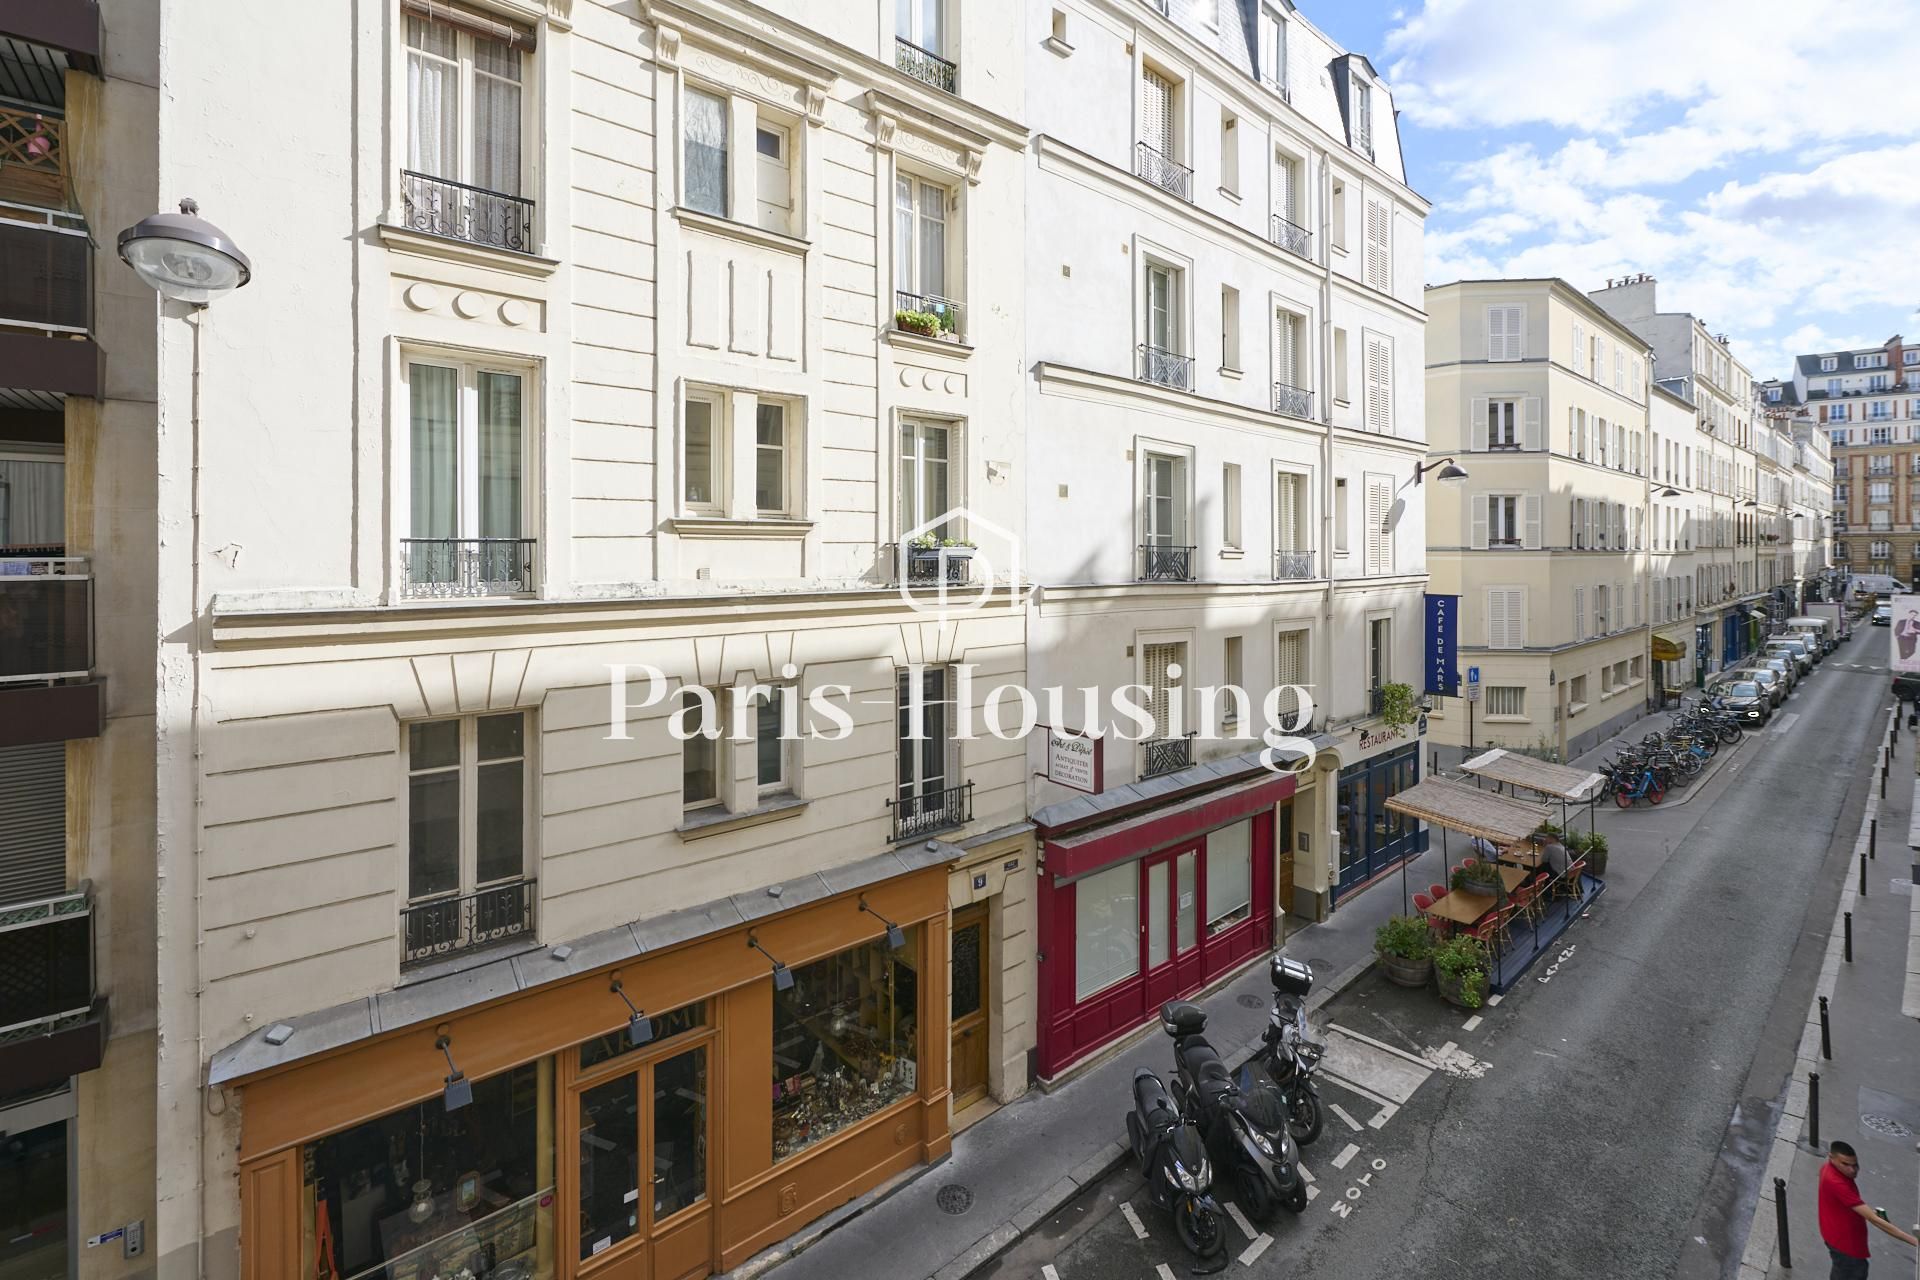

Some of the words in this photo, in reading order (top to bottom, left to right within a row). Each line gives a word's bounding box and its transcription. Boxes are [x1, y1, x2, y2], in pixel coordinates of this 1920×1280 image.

[1436, 600, 1445, 633] CAFE
[1436, 637, 1444, 654] DE
[1436, 658, 1445, 691] MARS
[1537, 944, 1577, 984] PAYANT
[1329, 1158, 1387, 1219] MOTO
